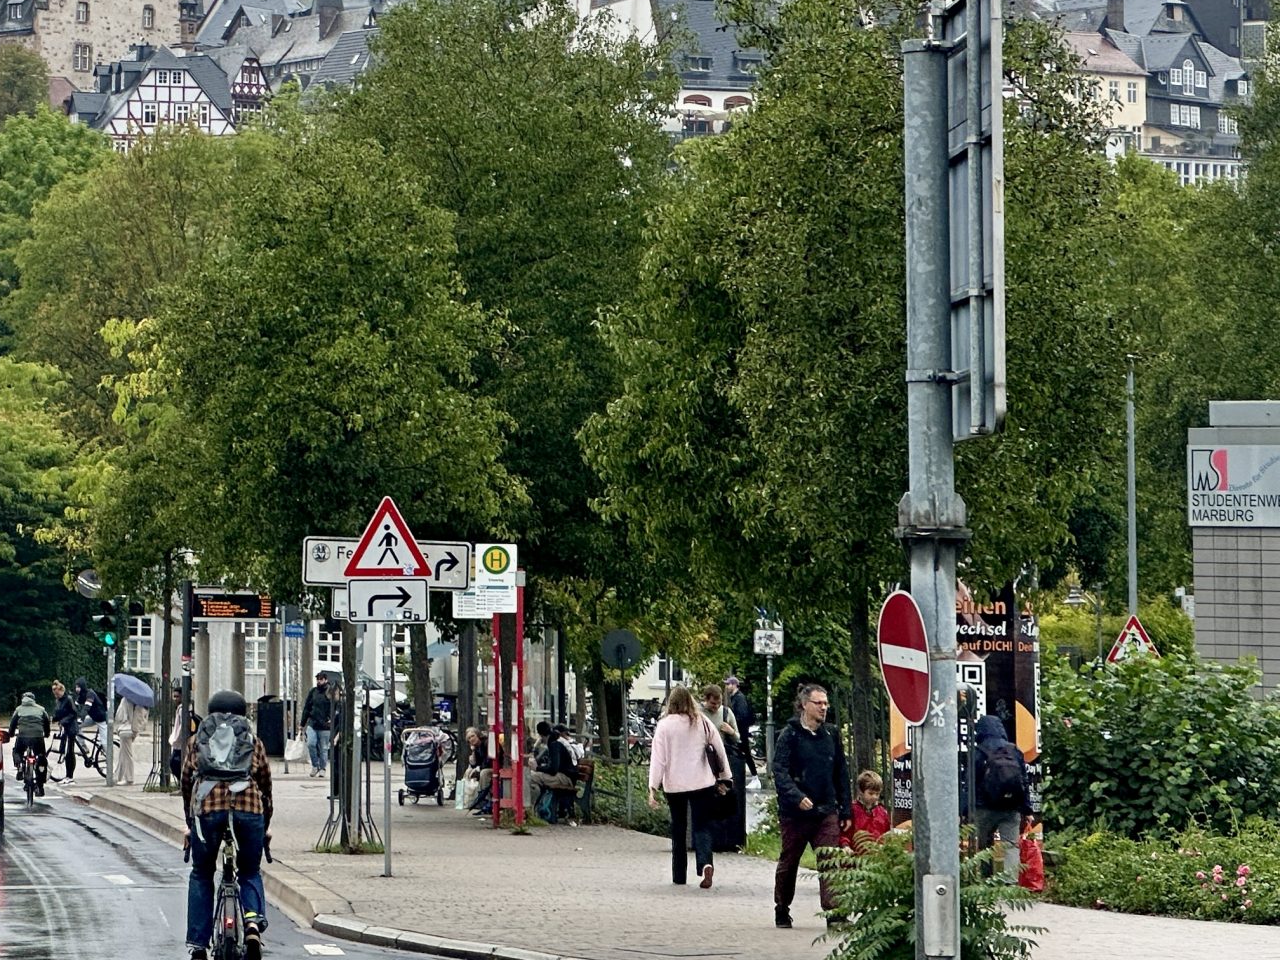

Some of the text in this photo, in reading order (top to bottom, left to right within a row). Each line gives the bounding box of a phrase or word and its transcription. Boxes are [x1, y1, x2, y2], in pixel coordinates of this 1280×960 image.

[1192, 509, 1254, 522] MARBURG
[962, 641, 1013, 652] auf DICH!
